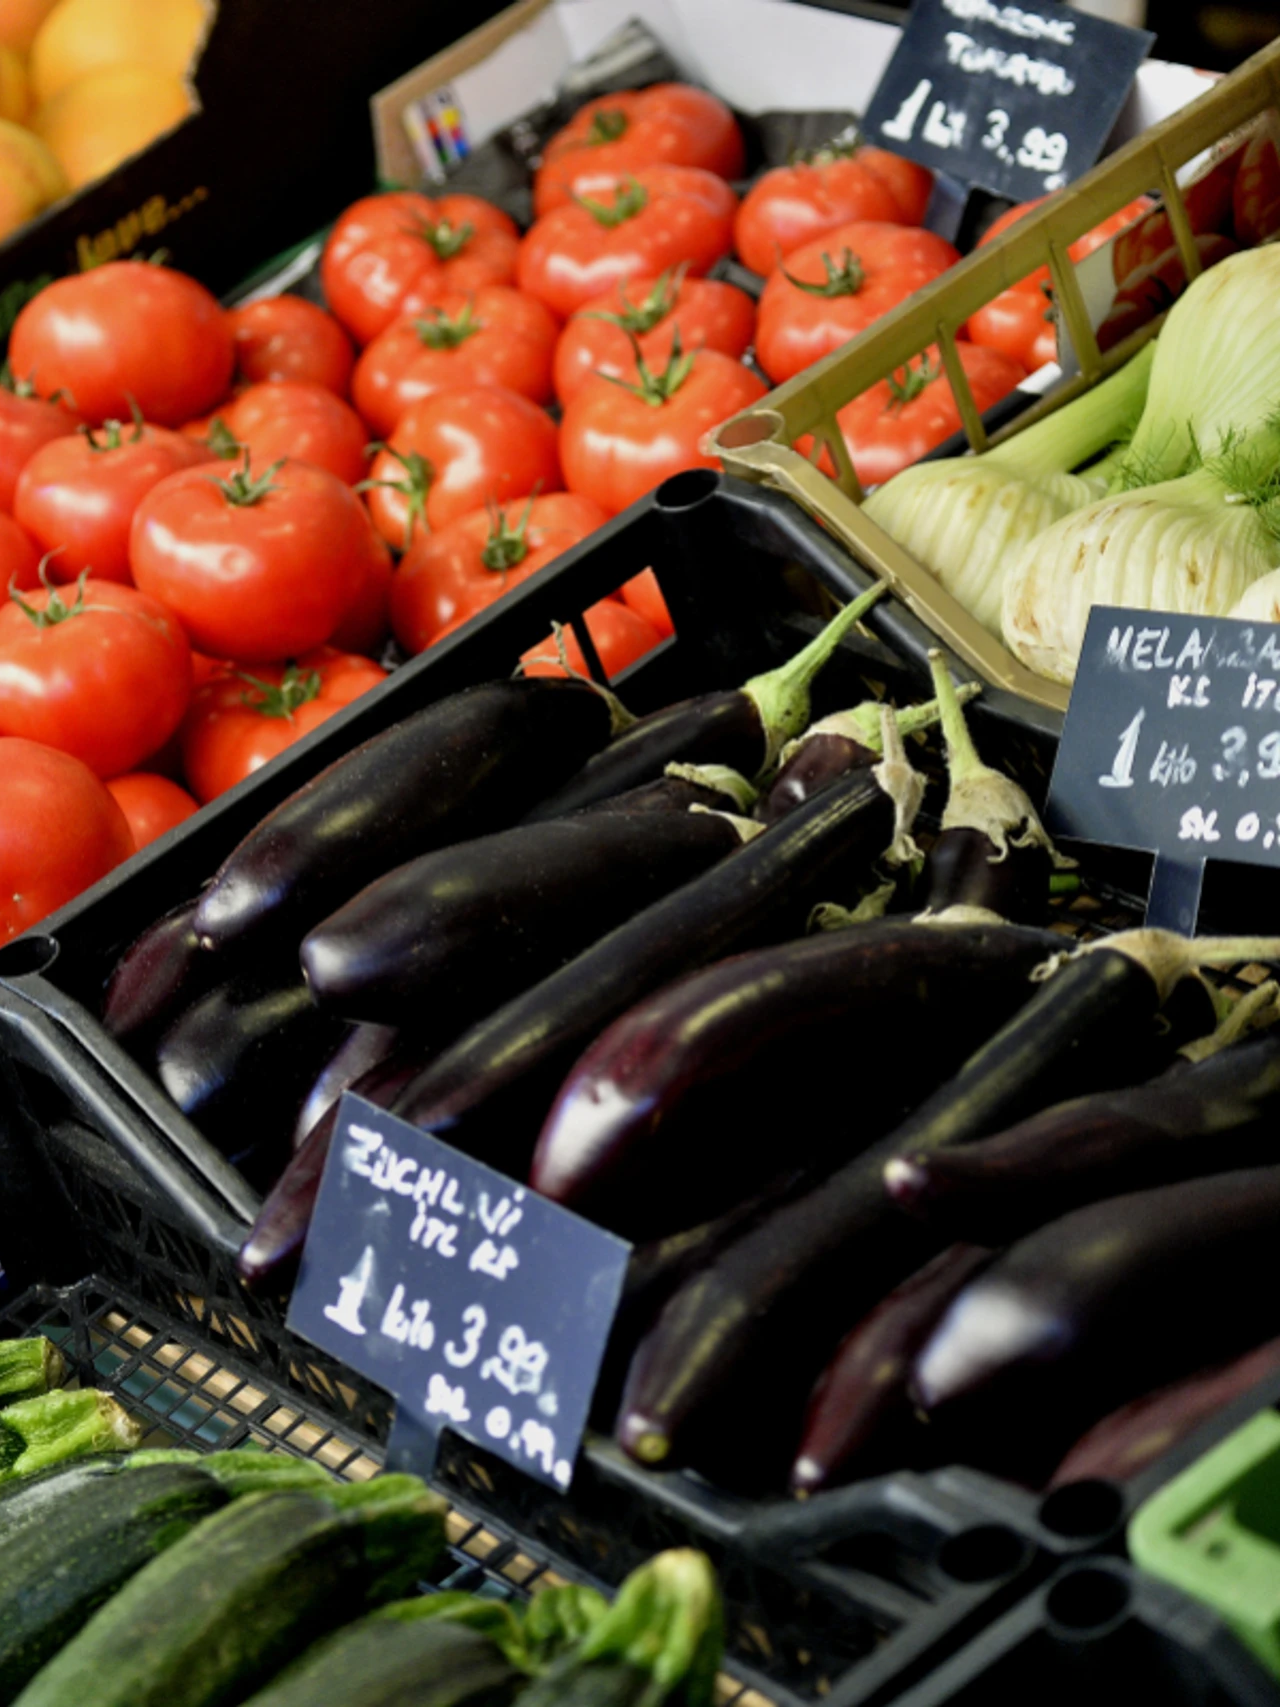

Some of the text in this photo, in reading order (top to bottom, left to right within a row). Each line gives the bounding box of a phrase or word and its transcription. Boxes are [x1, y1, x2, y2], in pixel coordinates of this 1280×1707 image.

[881, 78, 933, 142] 1
[1098, 706, 1146, 787] 1
[323, 1245, 367, 1335] 1
